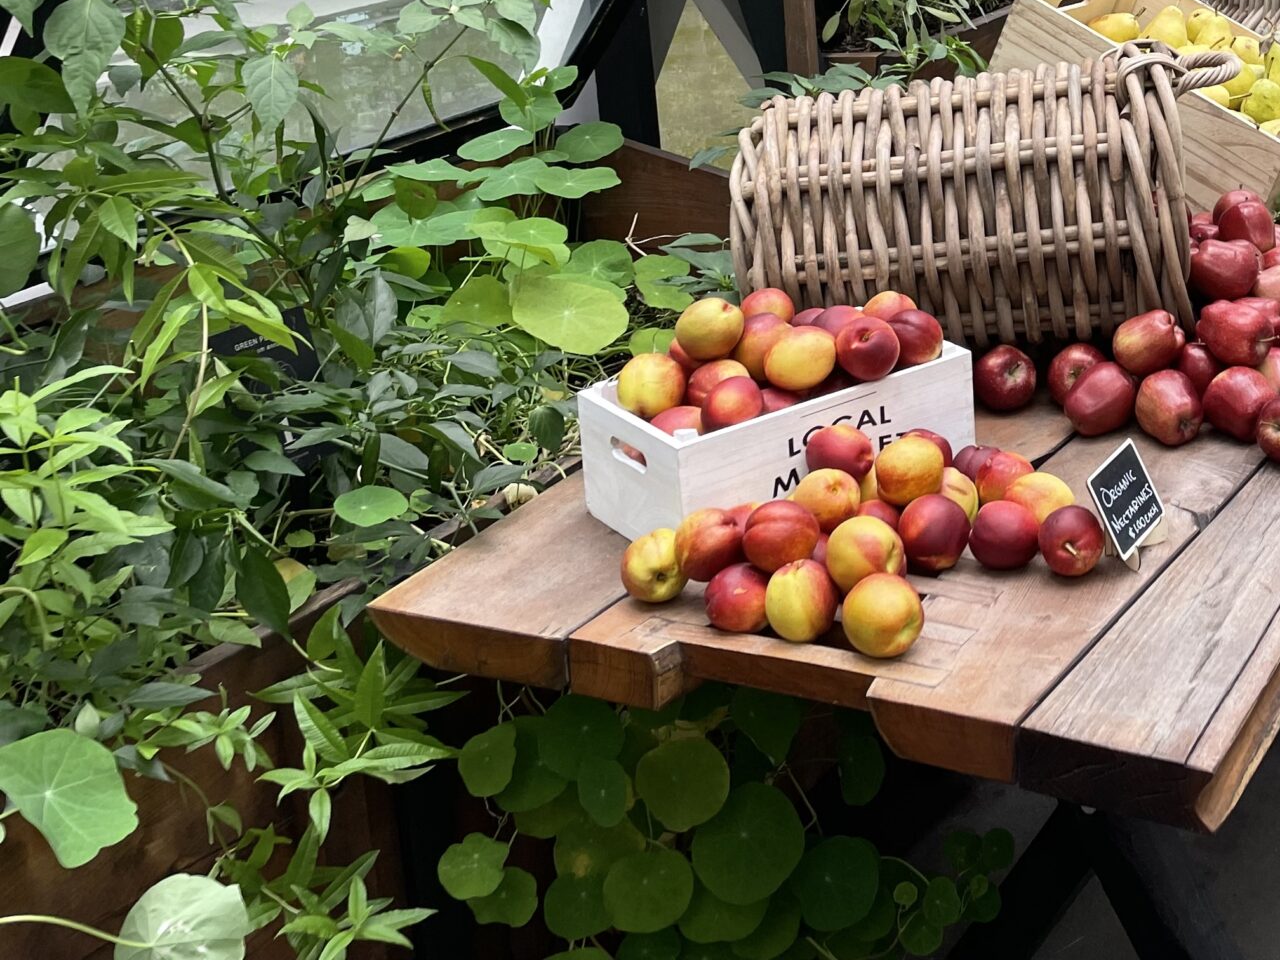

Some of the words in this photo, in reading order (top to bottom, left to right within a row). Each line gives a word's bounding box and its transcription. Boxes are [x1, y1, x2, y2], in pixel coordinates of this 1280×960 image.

[234, 338, 258, 352] GREEN
[1100, 470, 1136, 507] ORGANIC
[1111, 483, 1153, 534] NECTARINES
